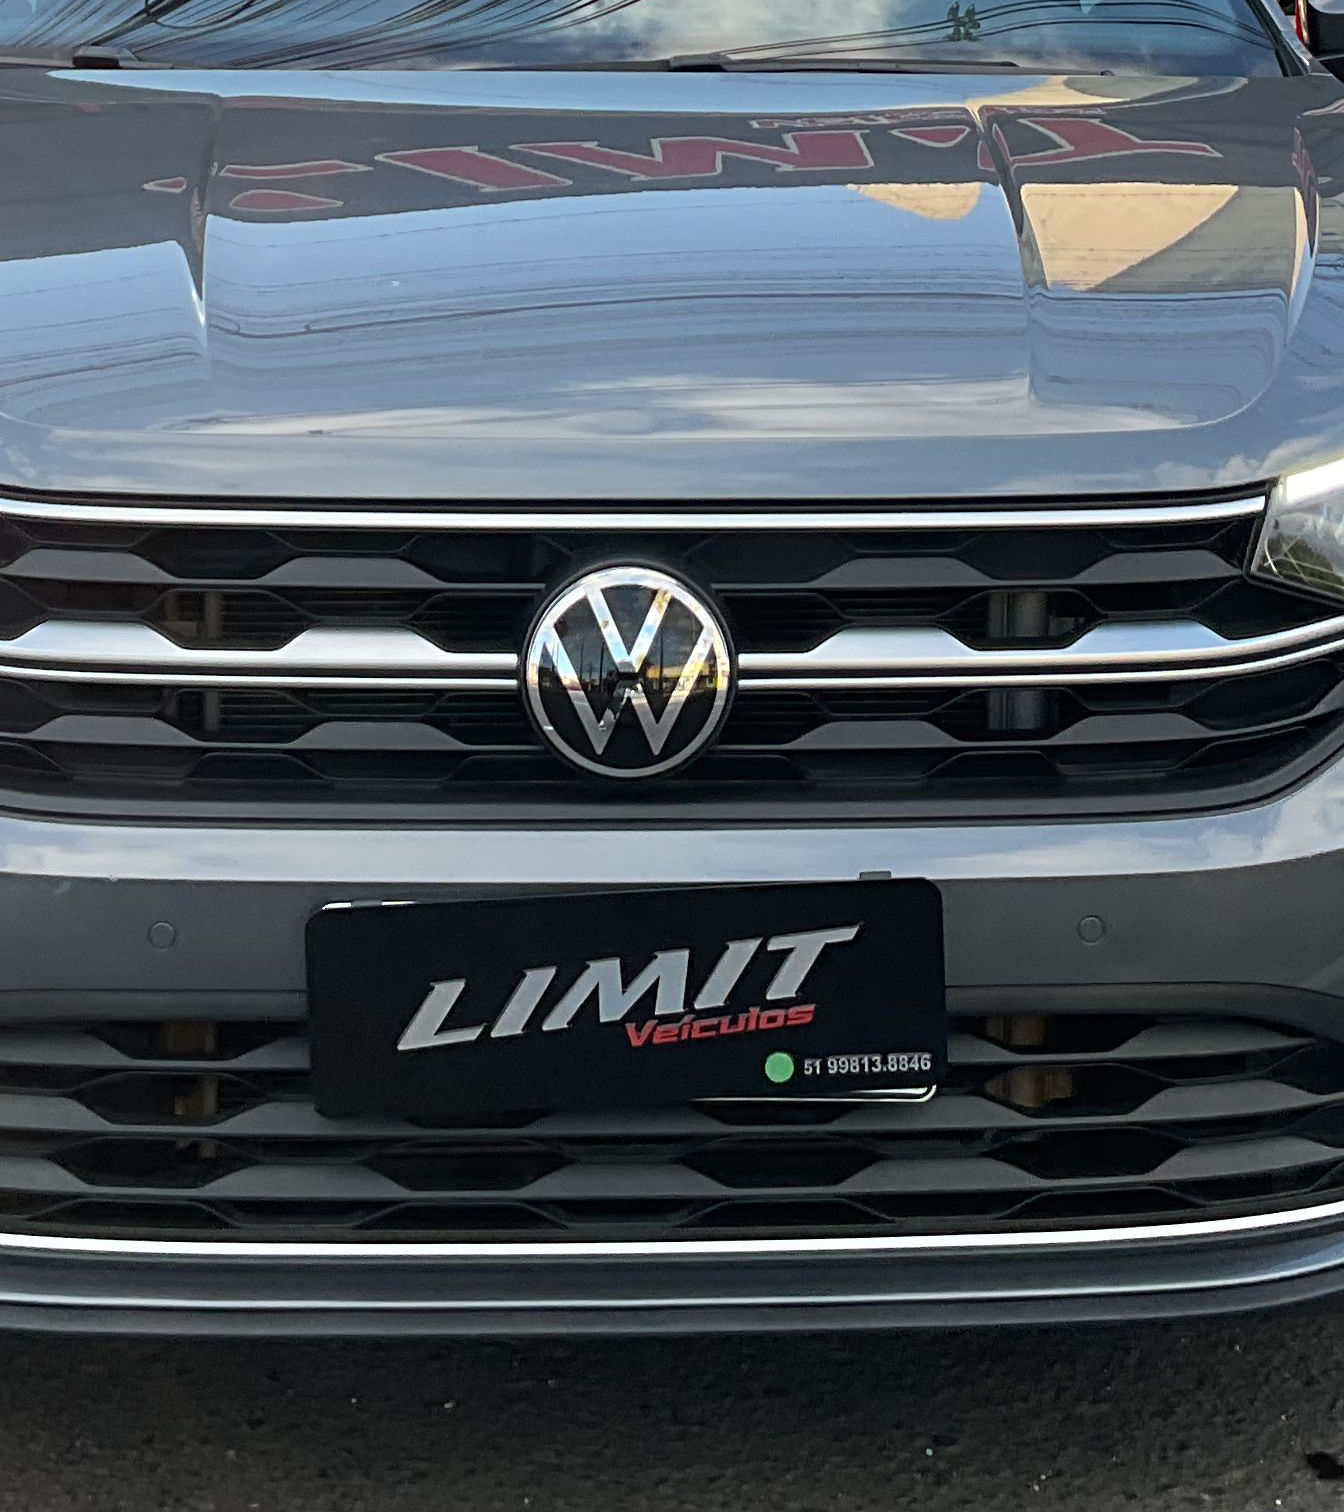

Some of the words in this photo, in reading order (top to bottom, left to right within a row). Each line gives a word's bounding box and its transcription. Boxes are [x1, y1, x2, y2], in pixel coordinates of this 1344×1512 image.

[397, 922, 864, 1050] LIMIT
[804, 1060, 821, 1075] 51
[827, 1054, 931, 1074] 99813.8846
